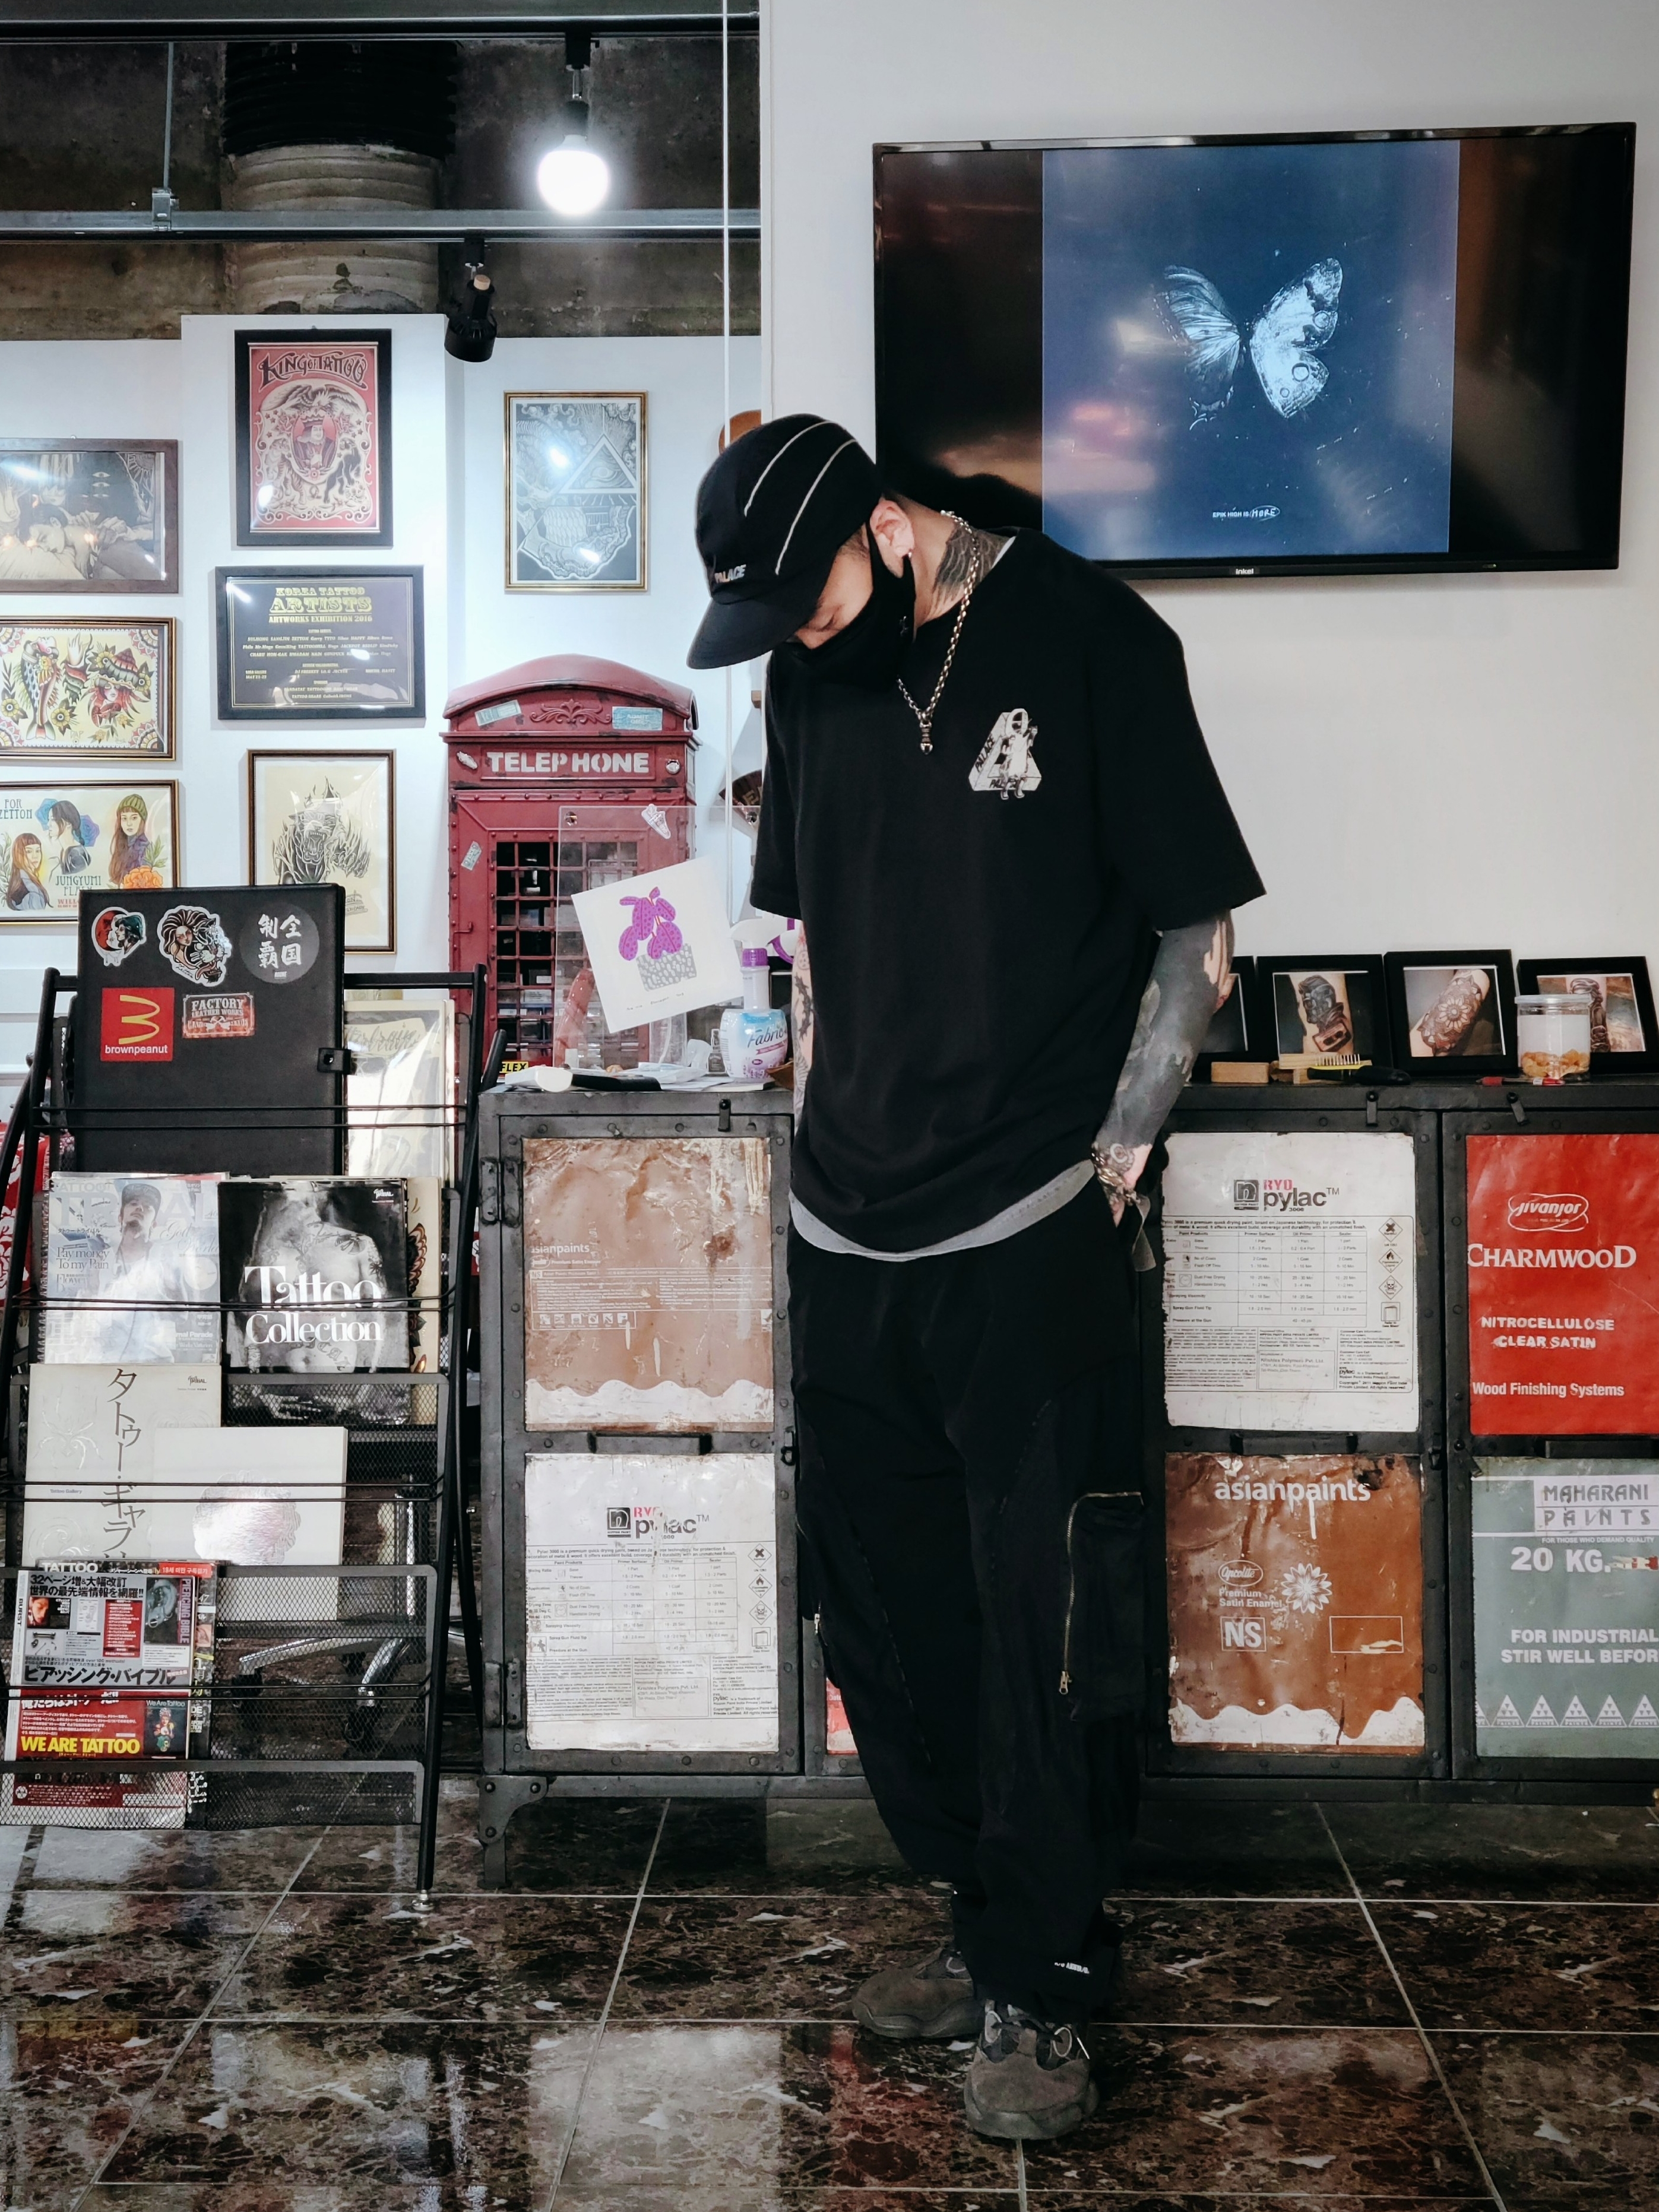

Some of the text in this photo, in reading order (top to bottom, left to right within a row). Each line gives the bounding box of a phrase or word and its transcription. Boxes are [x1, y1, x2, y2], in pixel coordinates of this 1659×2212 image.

[276, 587, 365, 596] KOREA TATTOO
[270, 597, 372, 613] ARTISTS
[486, 752, 649, 773] TELEPHONE
[5, 799, 22, 809] FOR
[55, 876, 102, 886] JUNGYUMI
[191, 997, 244, 1012] FACTORY
[192, 1009, 220, 1018] LEATHER
[105, 1044, 168, 1056] brownpeanut
[1264, 1188, 1326, 1212] pylac
[57, 1247, 110, 1262] Pay money
[1468, 1244, 1636, 1268] CHARMWOOD
[56, 1258, 109, 1272] To my Pain
[245, 1311, 385, 1343] Collection
[1481, 1317, 1615, 1331] NITROCELLULOSE
[1497, 1336, 1596, 1349] CLEAR SATIN
[1472, 1382, 1625, 1398] Wood Finishing Systems
[1214, 1475, 1371, 1513] asianpaints
[1544, 1484, 1649, 1504] MAHARANI
[1544, 1509, 1651, 1527] PAINTS
[42, 1562, 99, 1573] TATTOO
[1511, 1547, 1611, 1573] 20 KG.
[1219, 1588, 1261, 1598] Premium
[180, 1578, 192, 1643] PIERCING BIBLE
[1219, 1598, 1244, 1608] Satin
[1225, 1621, 1262, 1647] NS
[1511, 1629, 1659, 1643] FOR INDUSTRIAL
[1501, 1649, 1659, 1663] STIR WELL BEFOR
[21, 1736, 140, 1754] WE ARE TATTOO
